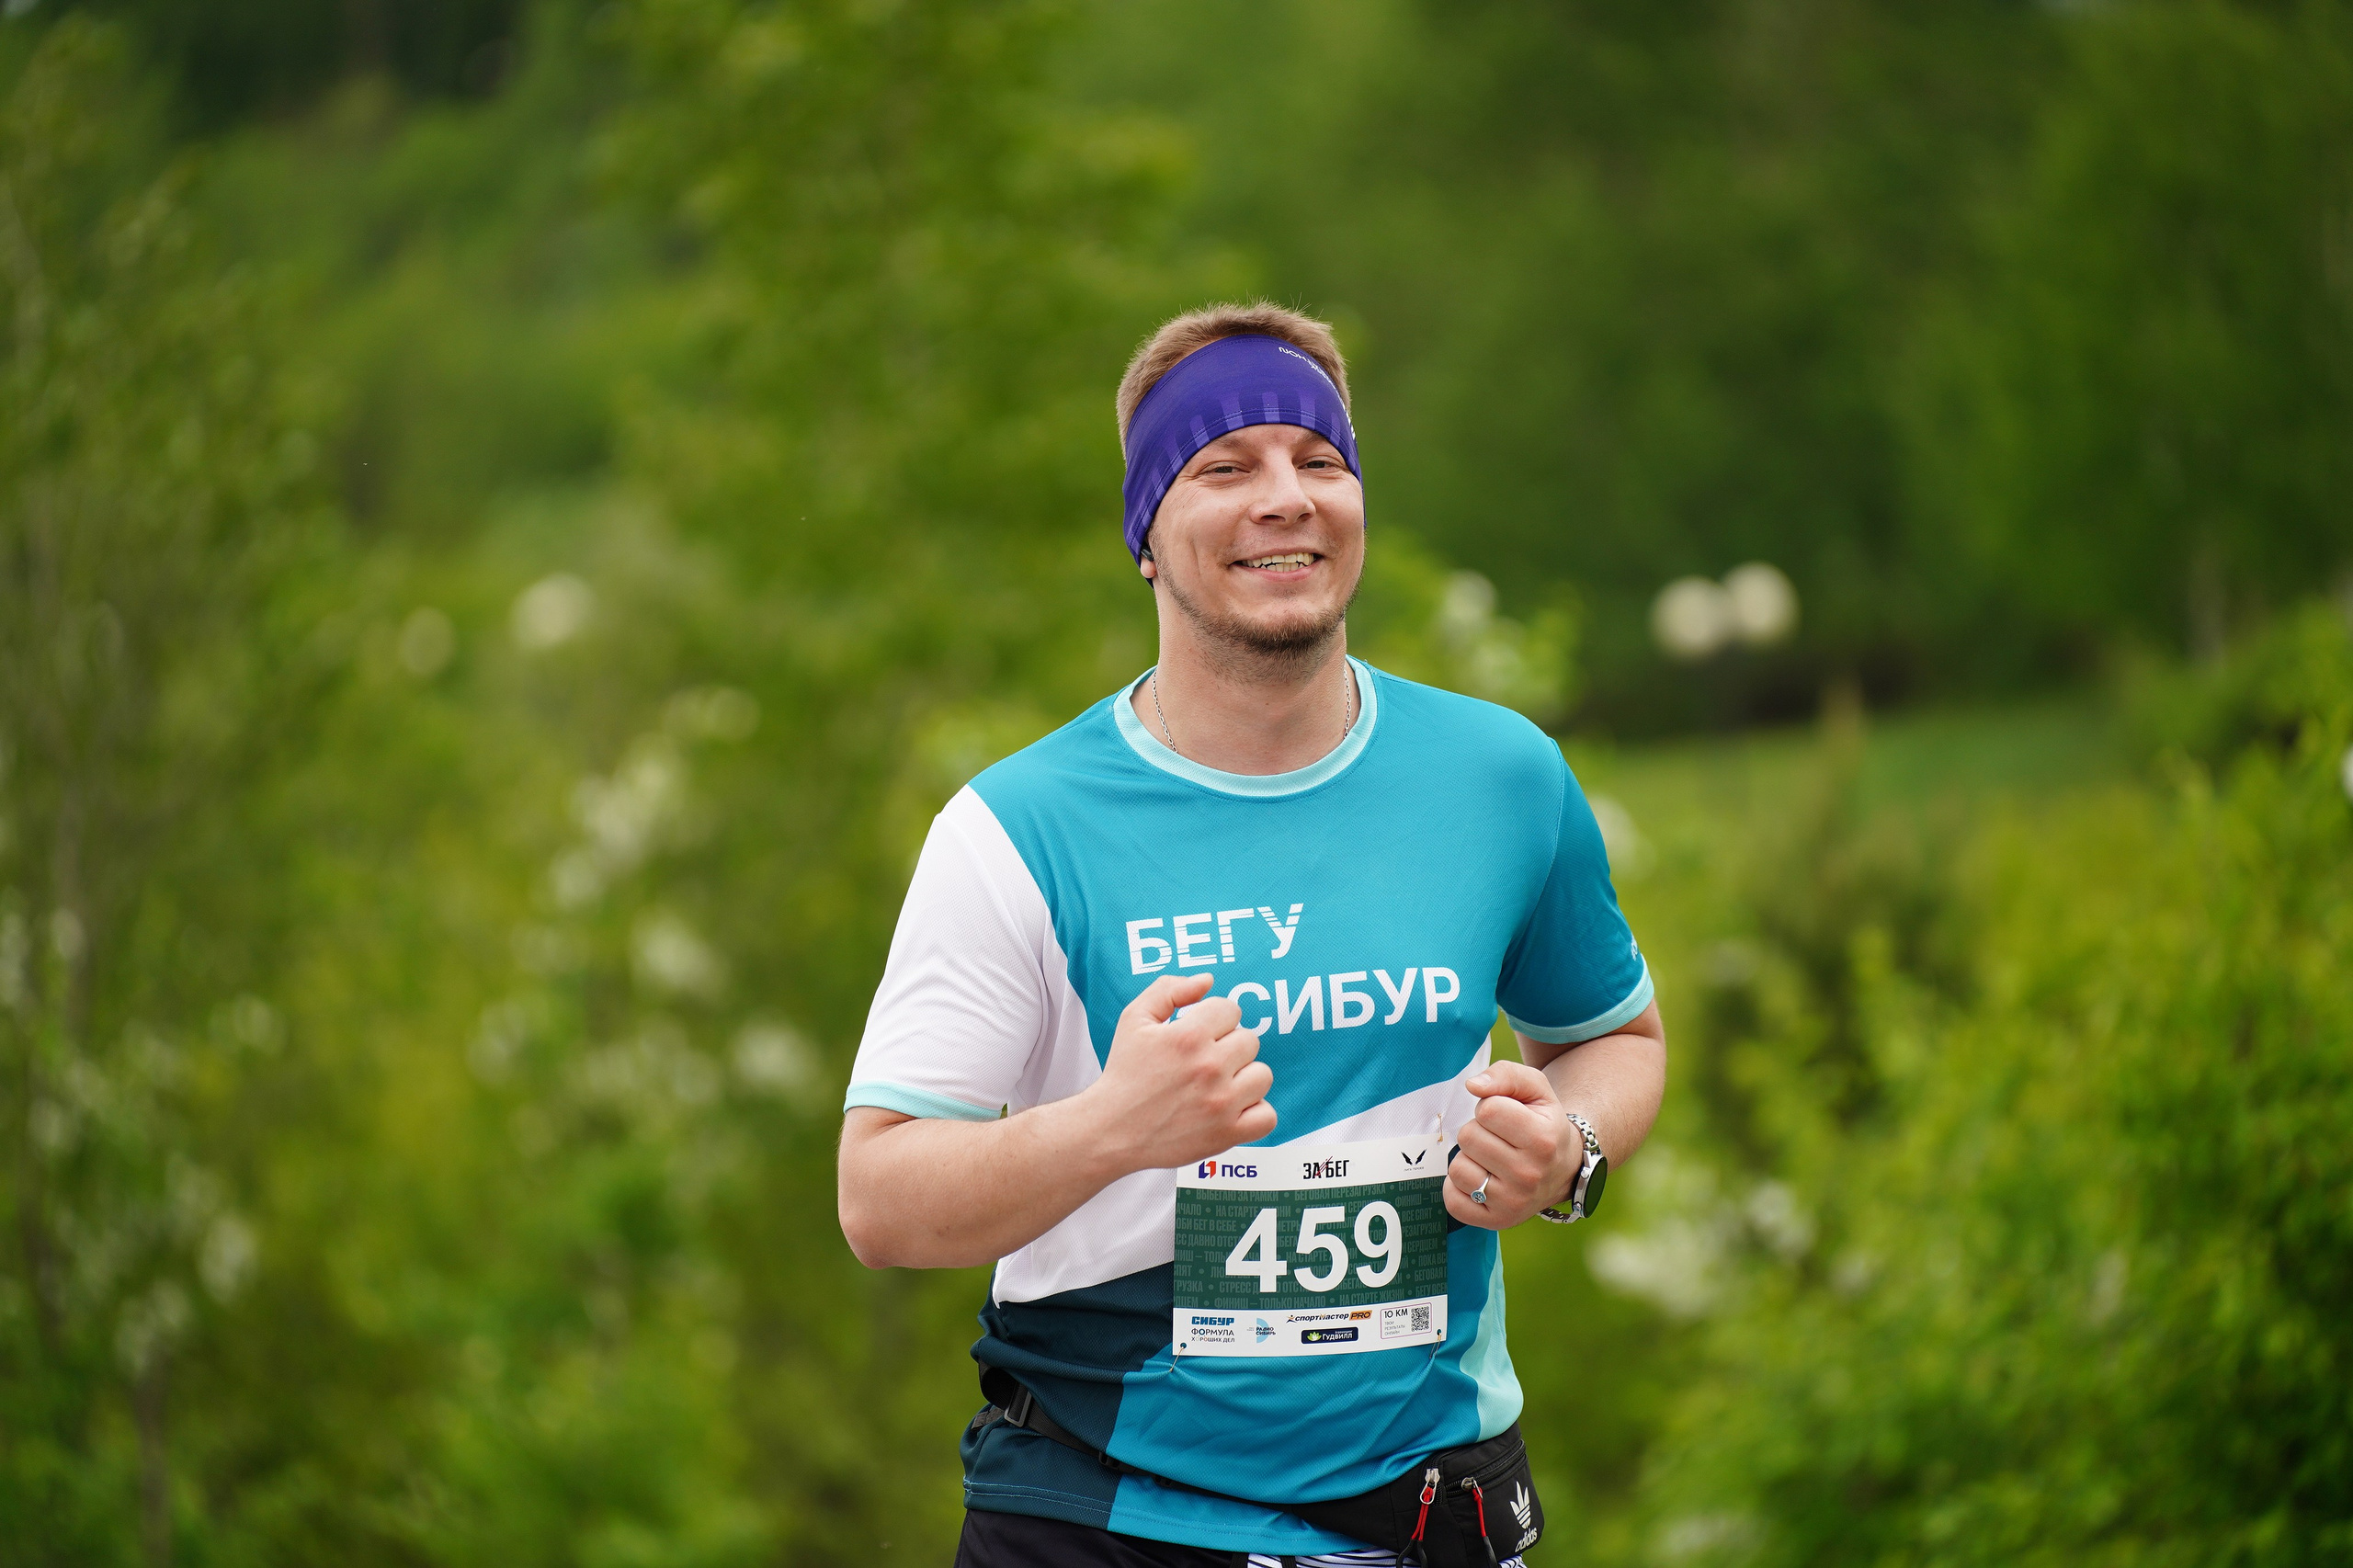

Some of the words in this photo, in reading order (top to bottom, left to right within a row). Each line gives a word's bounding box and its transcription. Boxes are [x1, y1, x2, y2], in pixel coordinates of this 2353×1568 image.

[1126, 903, 1304, 975] БЕГУ
[1227, 967, 1461, 1038] СИБУР
[1221, 1164, 1257, 1178] ПСБ
[1225, 1200, 1403, 1293] 459
[1191, 1316, 1234, 1325] СИБУР
[1350, 1312, 1371, 1320] PRO
[1384, 1310, 1393, 1318] 10
[1191, 1328, 1235, 1336] ФОРМУЛА
[1515, 1527, 1538, 1552] adidas
